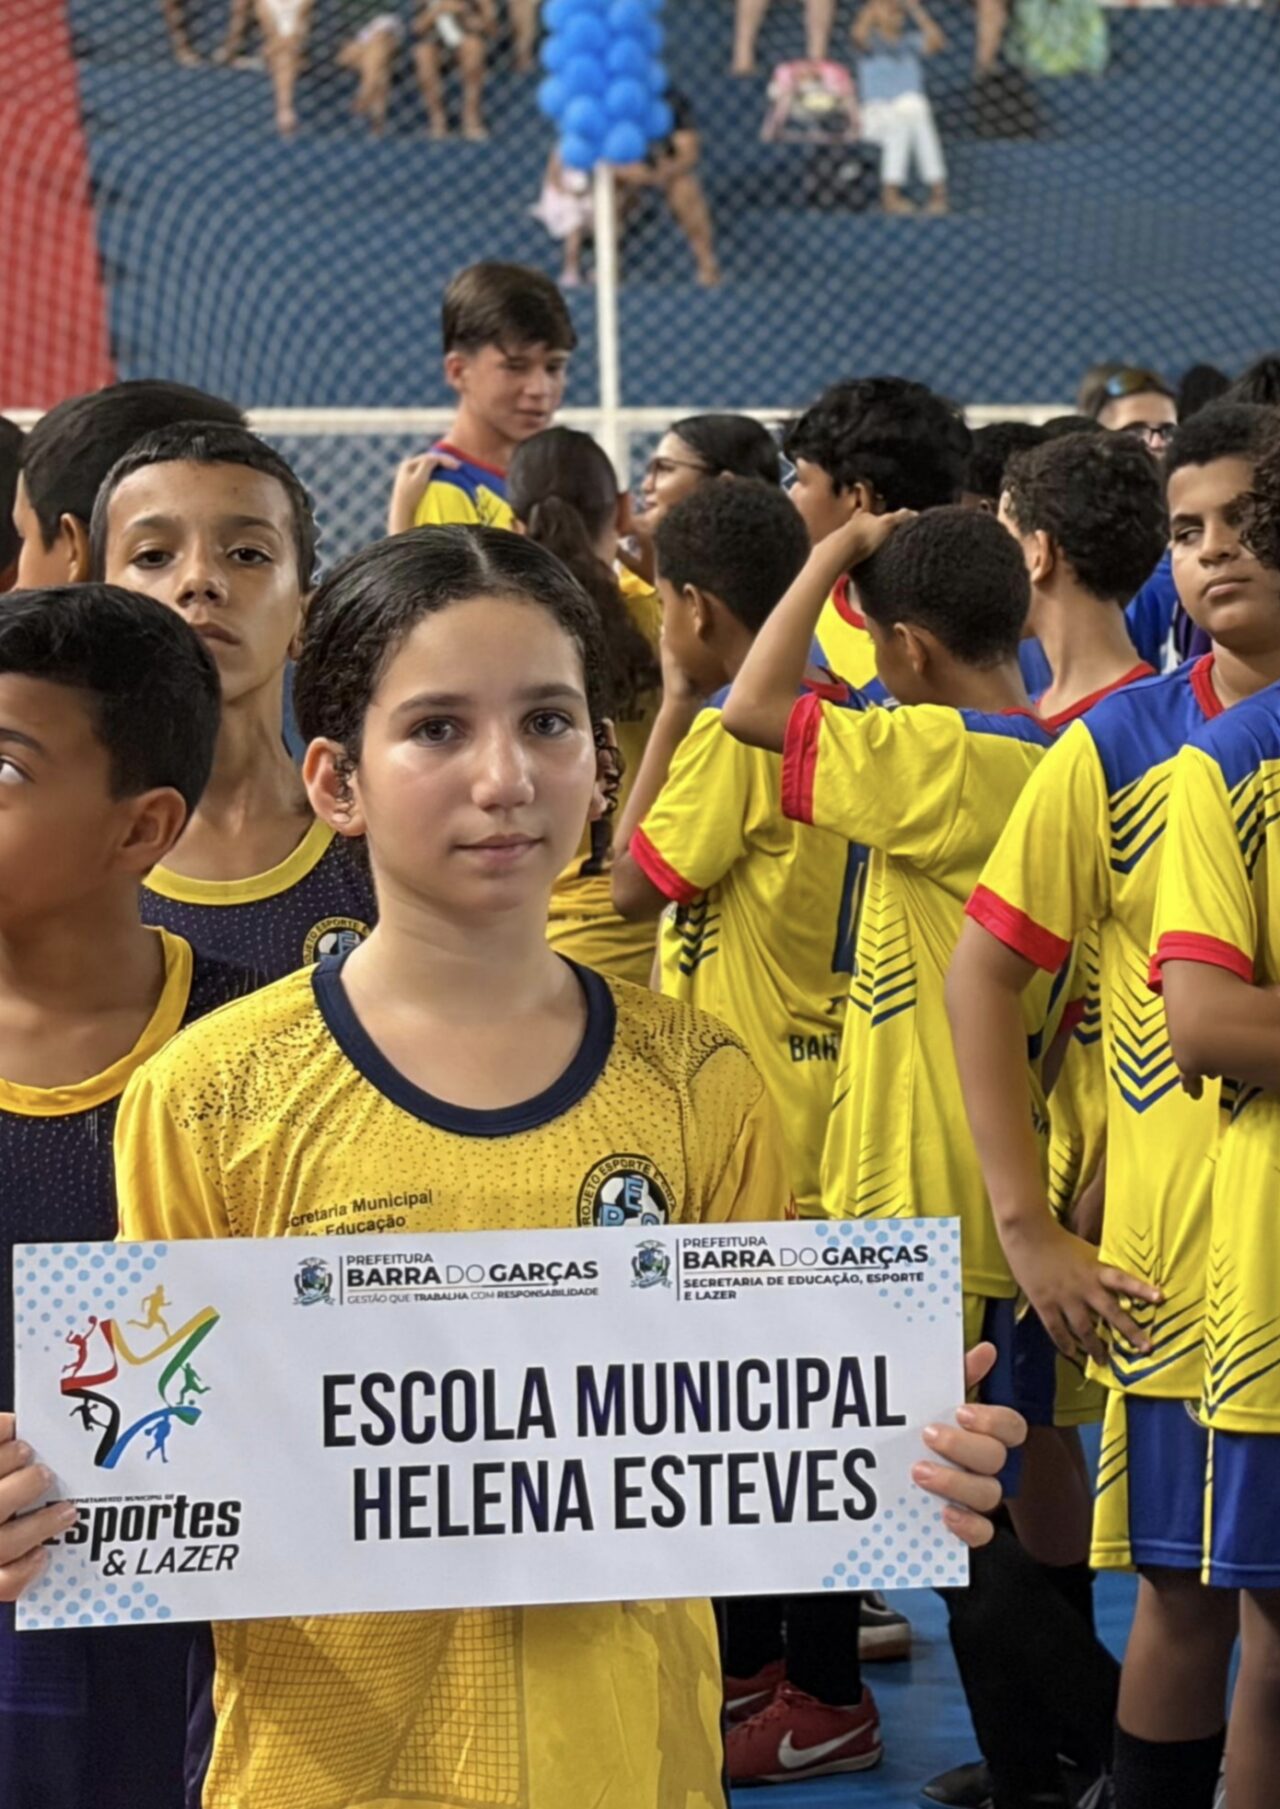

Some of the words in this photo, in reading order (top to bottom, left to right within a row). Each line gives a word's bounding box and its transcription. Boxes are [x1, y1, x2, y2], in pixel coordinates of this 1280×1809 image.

[581, 1174, 600, 1226] ROJETO
[600, 1159, 652, 1176] ESPORTE
[287, 1203, 348, 1228] cretaria
[352, 1188, 433, 1214] Municipal
[325, 1215, 406, 1236] Educação
[683, 1236, 767, 1248] PREFEITURA
[346, 1253, 434, 1266] PREFEITURA
[683, 1249, 775, 1270] BARRA
[780, 1247, 818, 1268] DO
[822, 1244, 929, 1270] GARÇAS
[347, 1266, 442, 1288] BARRA
[446, 1264, 485, 1284] DO
[489, 1261, 599, 1288] GARÇAS
[683, 1276, 764, 1289] SECRETARIA
[766, 1275, 785, 1286] DE
[788, 1271, 864, 1286] EDUCAÇÃO,
[866, 1271, 925, 1284] ESPORTE
[347, 1291, 388, 1305] GESTÃO
[389, 1293, 411, 1304] QUE
[413, 1291, 469, 1302] TRABALHA
[470, 1289, 495, 1300] COM
[496, 1286, 599, 1300] RESPONSABILIDADE
[684, 1291, 692, 1301] E
[695, 1289, 738, 1301] LAZER
[323, 1366, 557, 1447] ESCOLA
[576, 1355, 907, 1437] MUNICIPAL
[354, 1459, 594, 1541] HELENA
[614, 1448, 878, 1530] ESTEVES
[102, 1549, 127, 1577] &
[135, 1544, 240, 1575] LAZER
